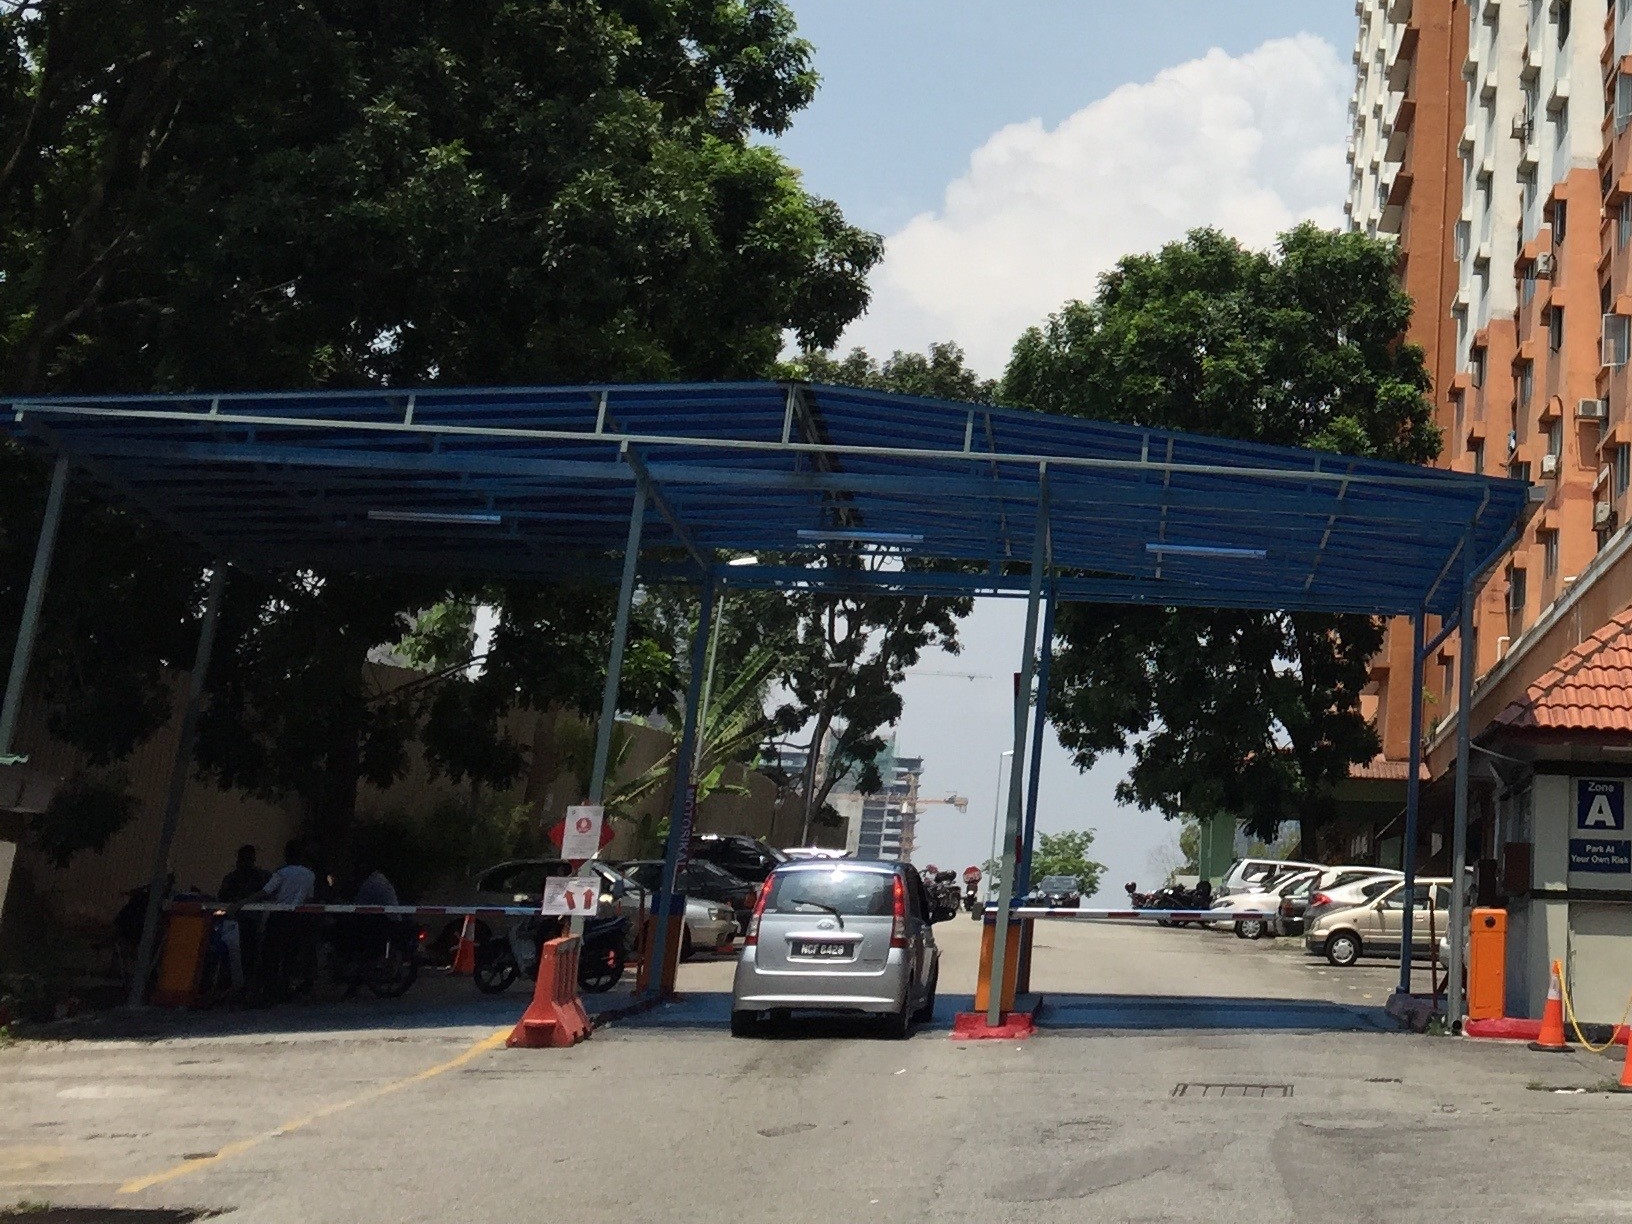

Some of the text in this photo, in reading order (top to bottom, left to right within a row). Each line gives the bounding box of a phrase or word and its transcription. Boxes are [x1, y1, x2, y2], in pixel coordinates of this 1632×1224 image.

[1588, 782, 1615, 793] Zone
[1585, 794, 1617, 827] A
[1585, 844, 1615, 854] Park At
[1571, 854, 1629, 865] Your Own Risk
